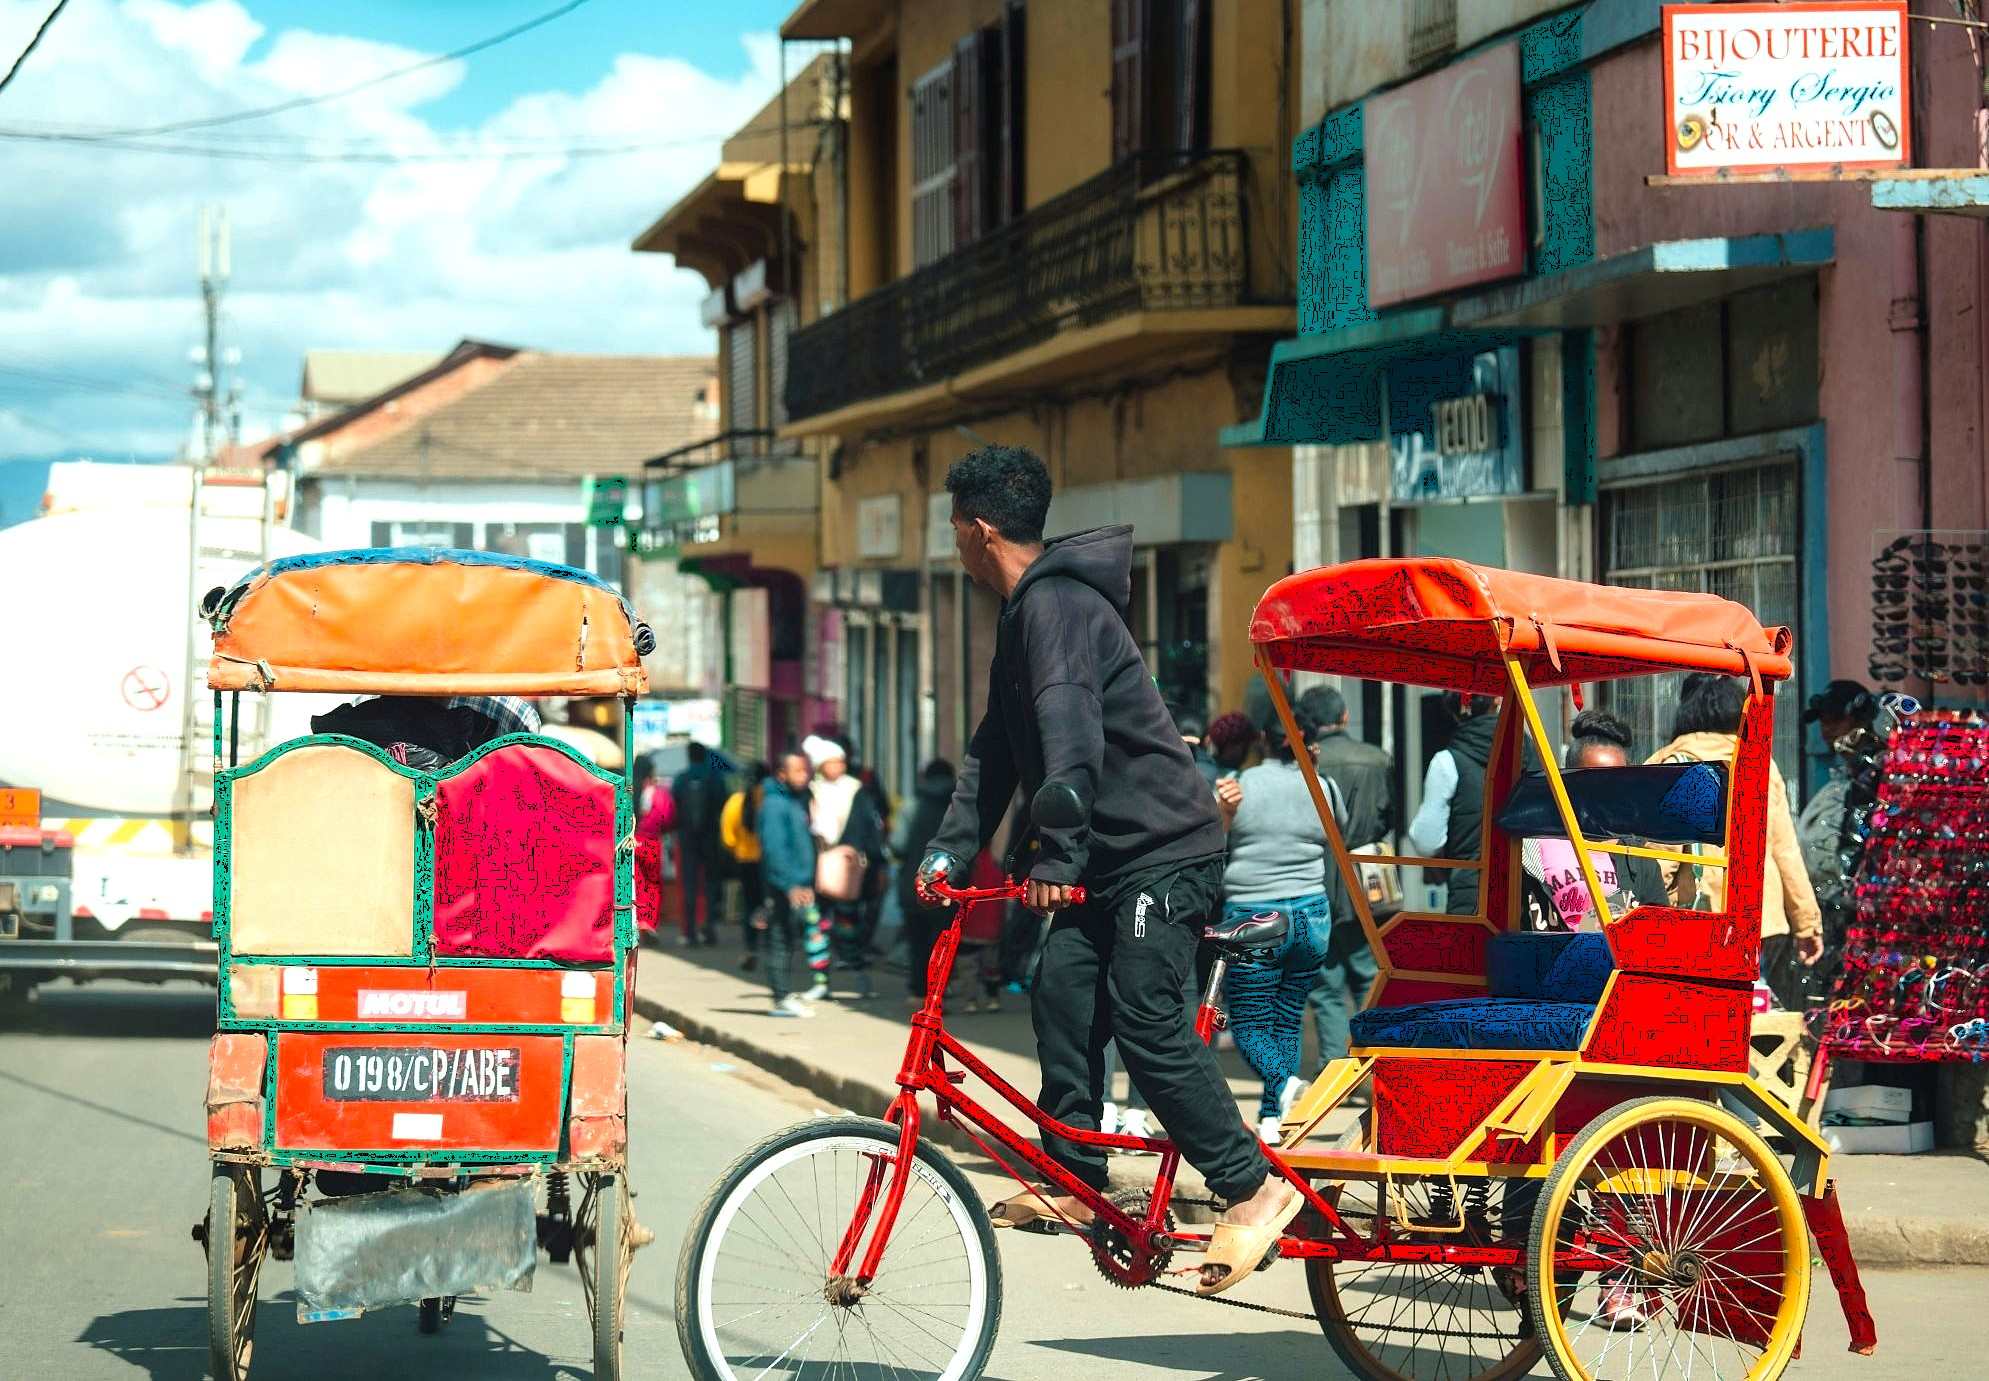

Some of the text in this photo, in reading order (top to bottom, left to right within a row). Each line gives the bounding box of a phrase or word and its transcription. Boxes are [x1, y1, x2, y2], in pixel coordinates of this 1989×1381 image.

[1679, 26, 1897, 69] BIJOUTERIE
[1679, 69, 1896, 118] Tsiory Sergio
[1703, 118, 1870, 150] OR & ARGENT
[362, 993, 462, 1016] MOTUL
